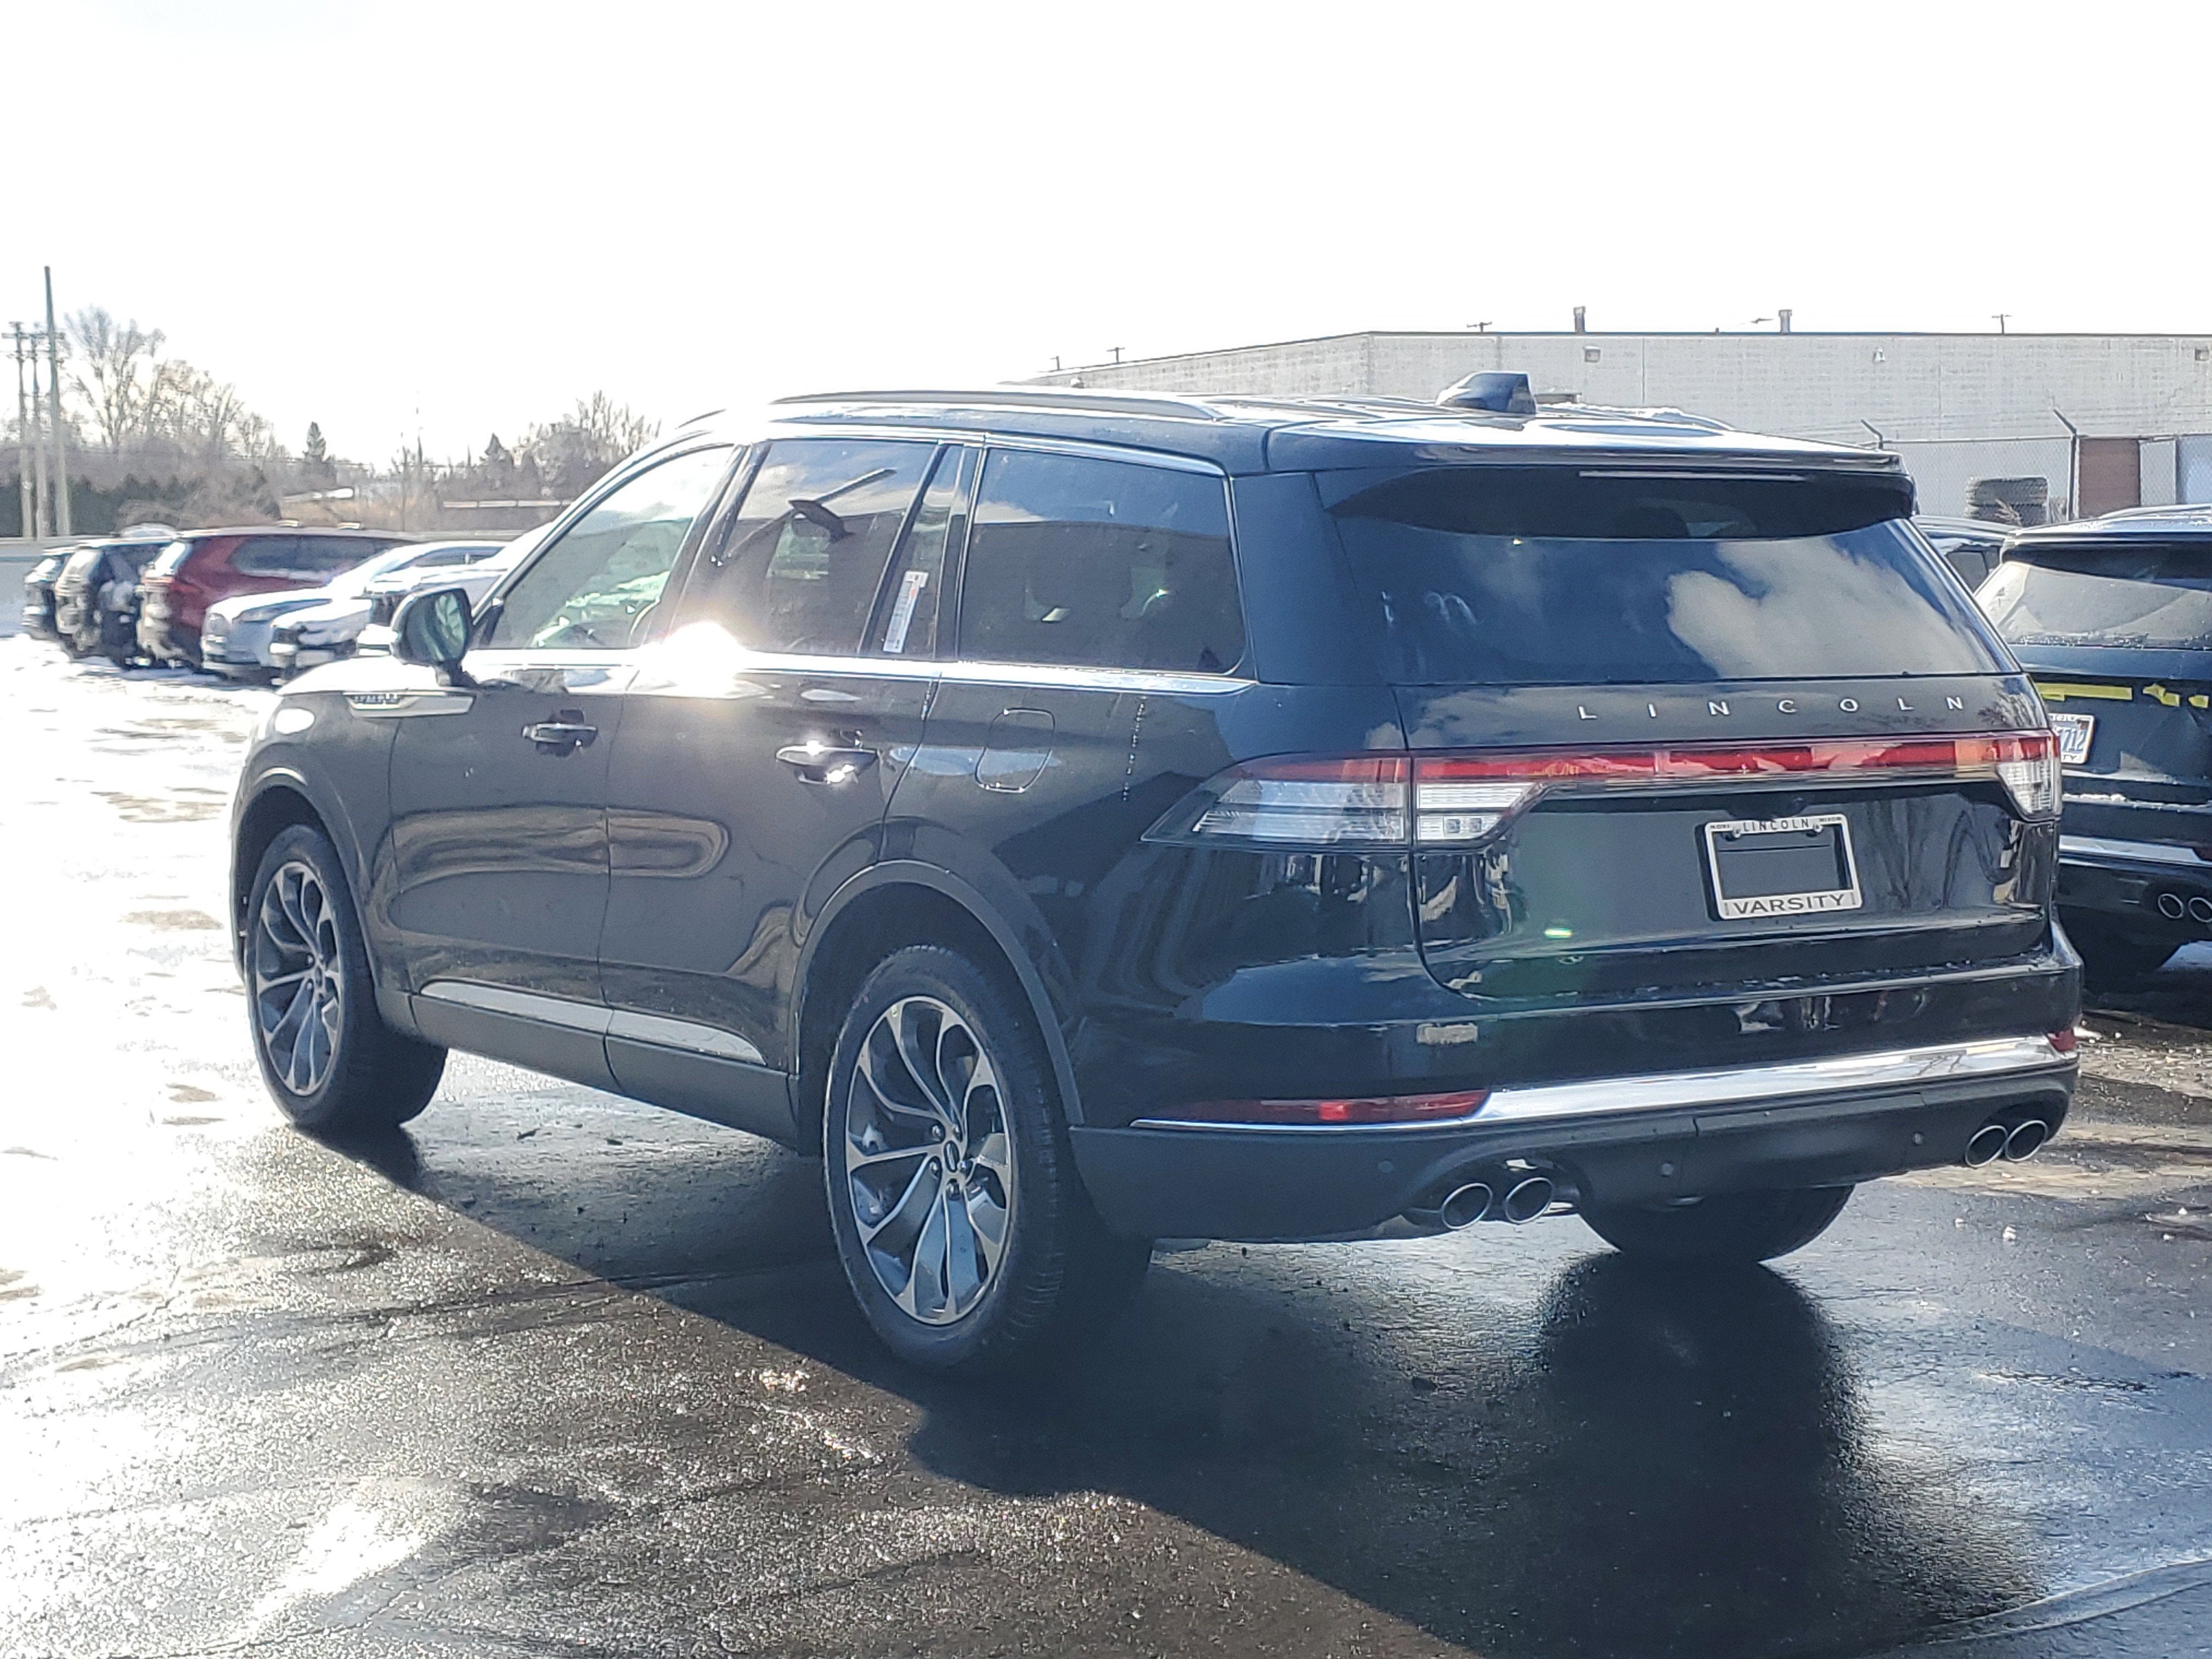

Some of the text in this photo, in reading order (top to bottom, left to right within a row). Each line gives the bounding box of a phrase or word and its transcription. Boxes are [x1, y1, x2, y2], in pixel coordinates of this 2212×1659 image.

[1578, 696, 1965, 720] LINCOLN
[1742, 818, 1809, 832] LINCOLN
[1733, 894, 1845, 915] VARSITY
